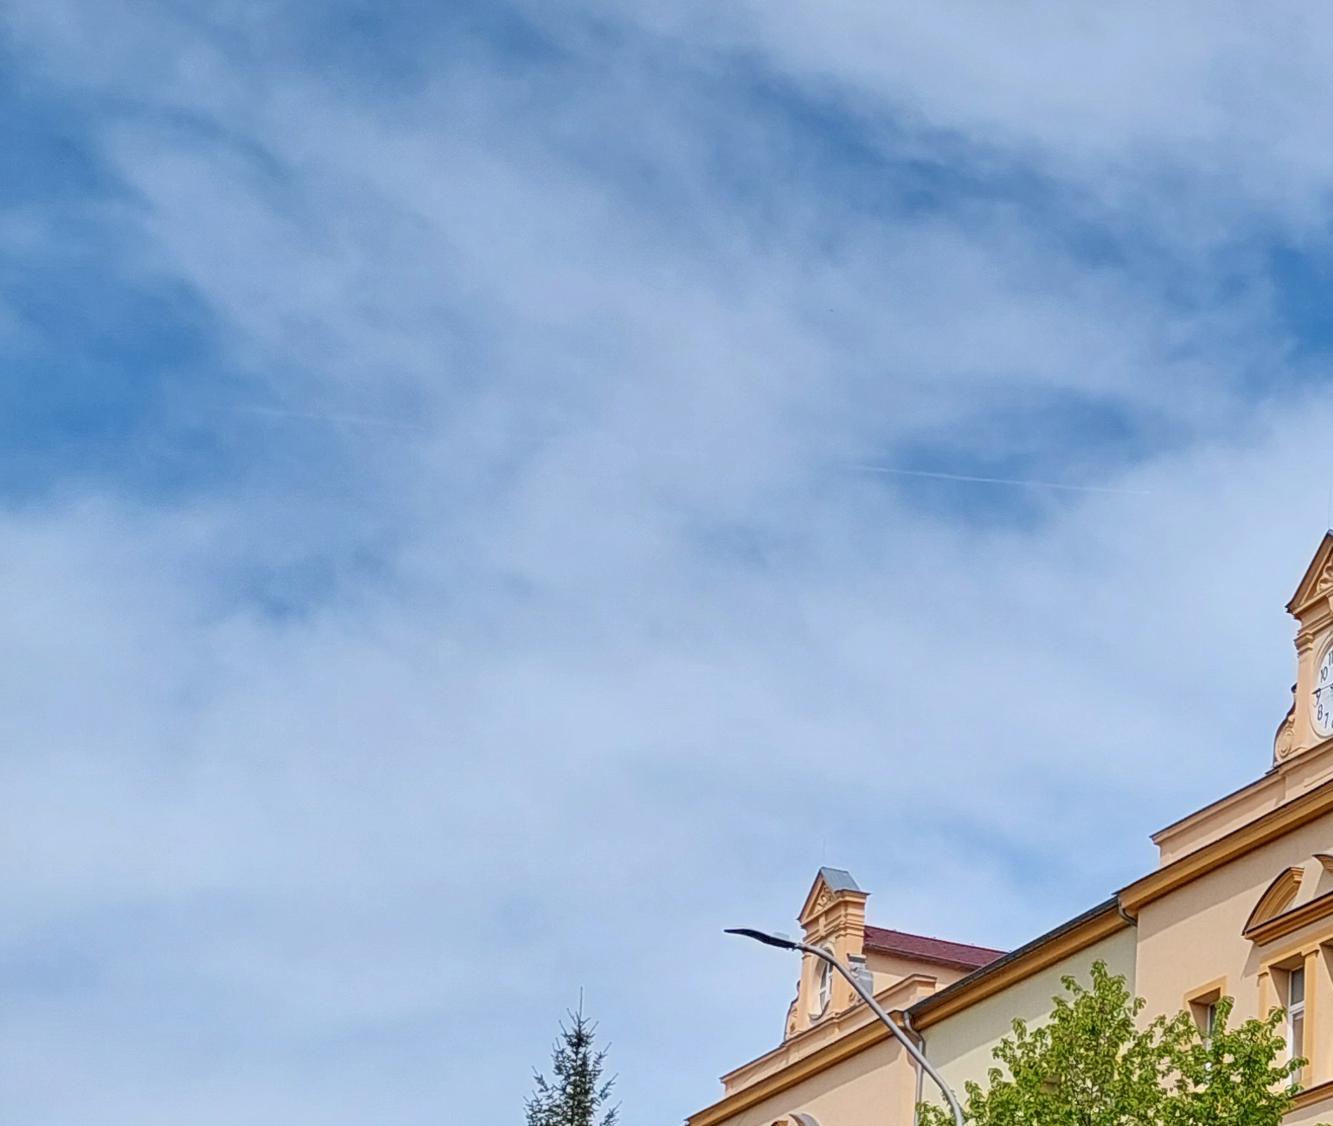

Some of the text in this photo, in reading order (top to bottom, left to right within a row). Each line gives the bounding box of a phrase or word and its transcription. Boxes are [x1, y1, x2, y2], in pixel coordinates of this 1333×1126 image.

[1329, 650, 1333, 666] 11
[1321, 666, 1328, 683] 10
[1317, 704, 1323, 721] 8
[1324, 712, 1329, 728] 7
